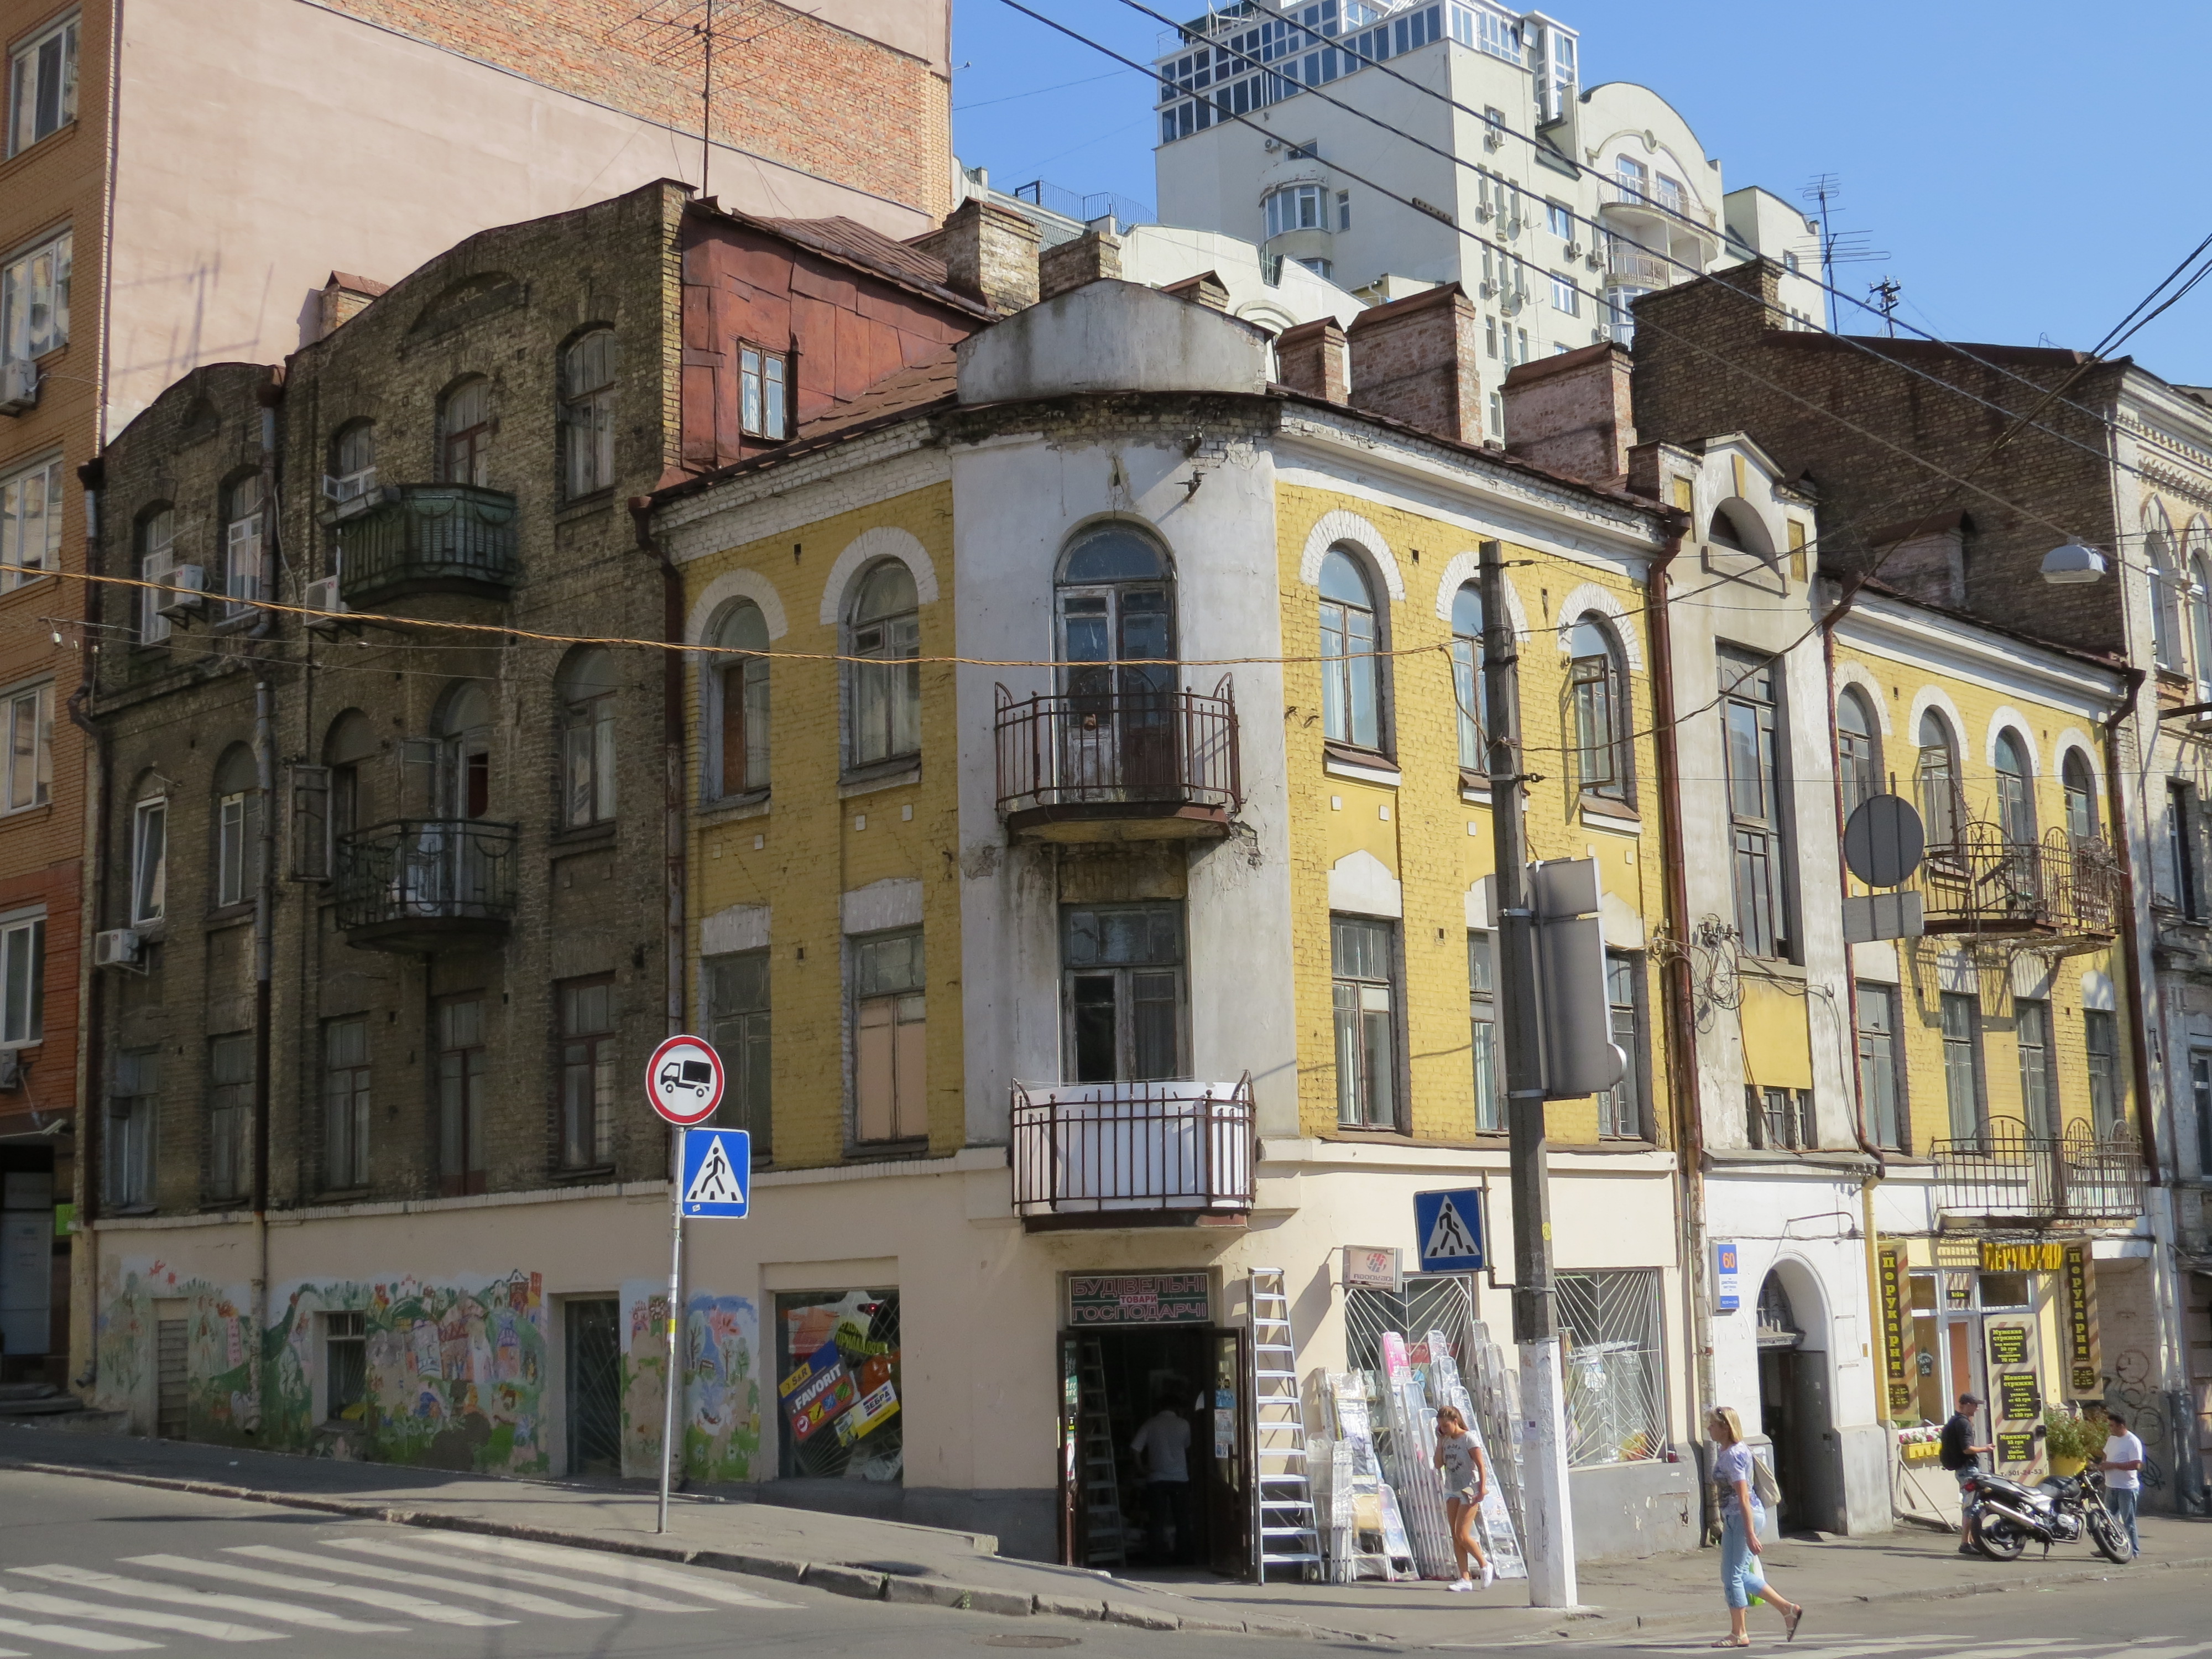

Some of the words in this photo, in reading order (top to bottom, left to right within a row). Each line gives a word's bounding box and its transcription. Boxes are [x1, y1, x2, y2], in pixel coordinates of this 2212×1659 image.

[1723, 1252, 1735, 1269] 60
[1072, 1276, 1206, 1298] БУДІВЕЛЬНІ
[1120, 1295, 1157, 1304] ТОВАРИ
[2069, 1252, 2088, 1355] Перукарня
[1072, 1302, 1207, 1321] ГОСПОДАРЧІ
[1882, 1256, 1901, 1371] Перукарня
[795, 1363, 841, 1411] FAVORIT
[864, 1390, 891, 1413] ЗЕБРА
